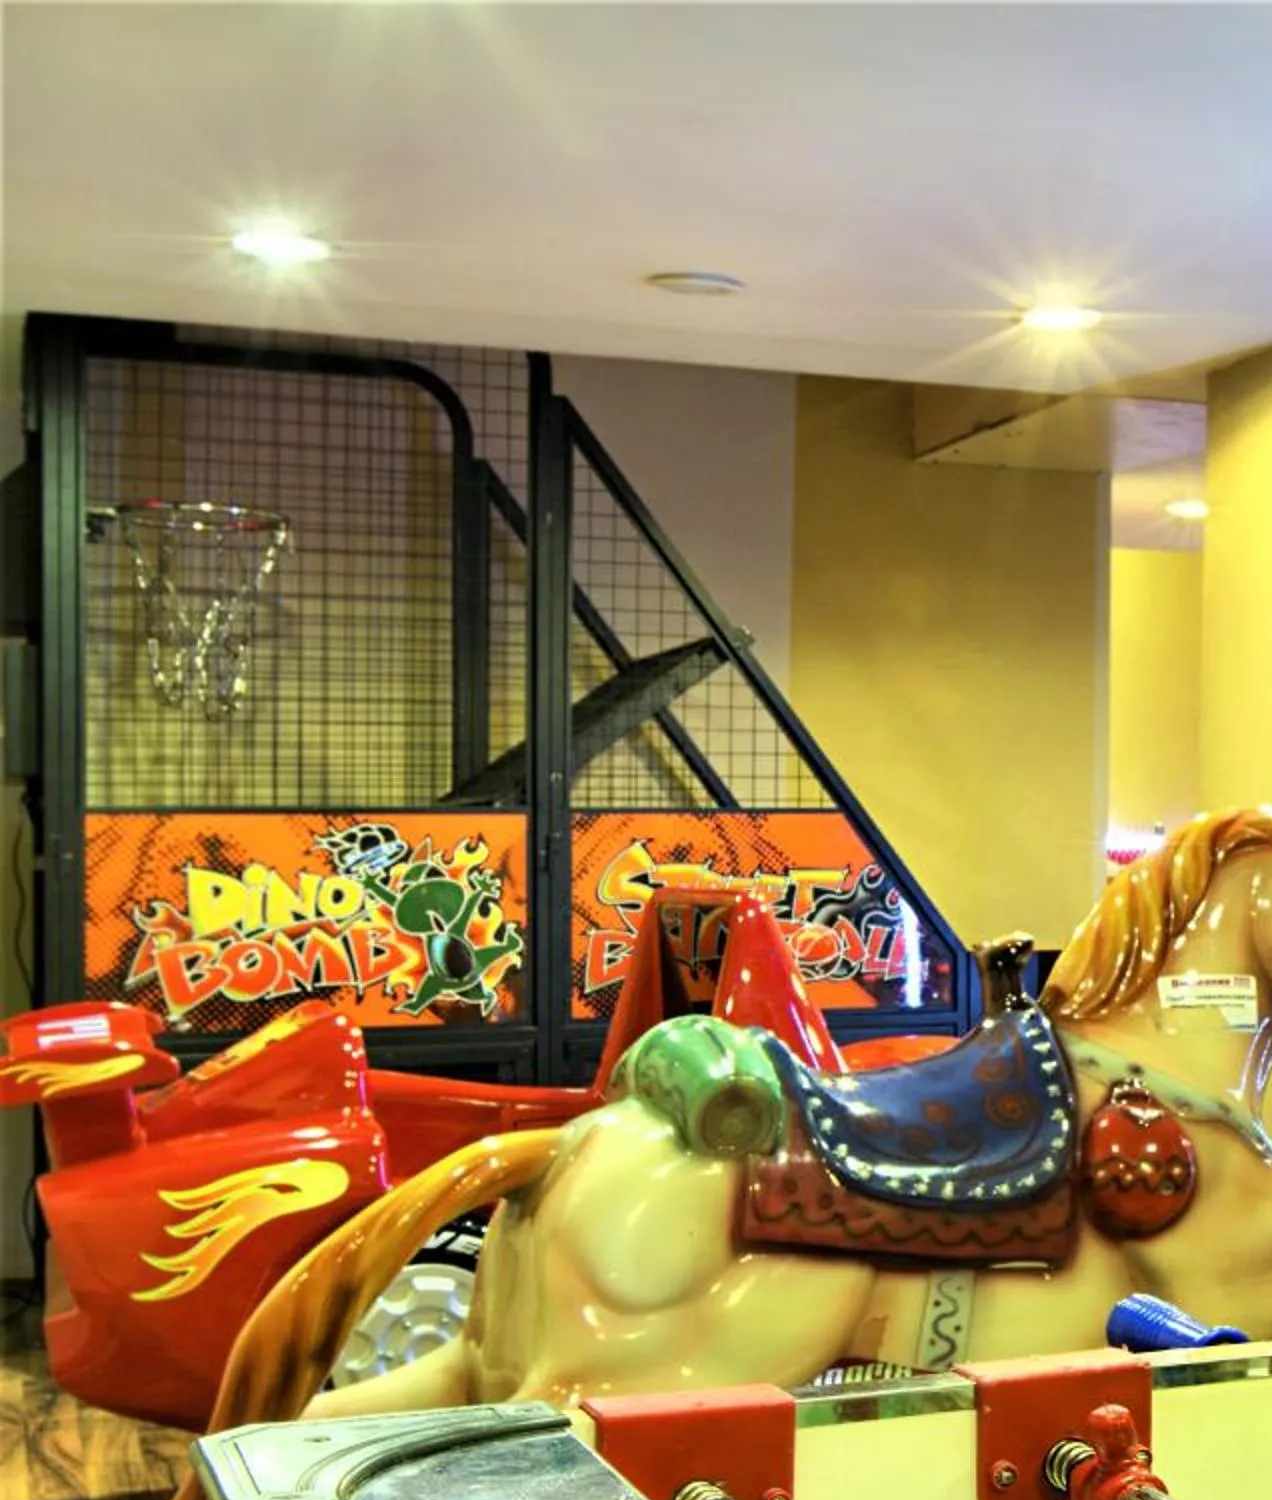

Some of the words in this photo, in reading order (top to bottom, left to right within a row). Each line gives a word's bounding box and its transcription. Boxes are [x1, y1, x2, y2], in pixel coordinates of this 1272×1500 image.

[598, 842, 850, 923] STET
[154, 925, 412, 1019] BOMB
[584, 914, 928, 992] BAALL
